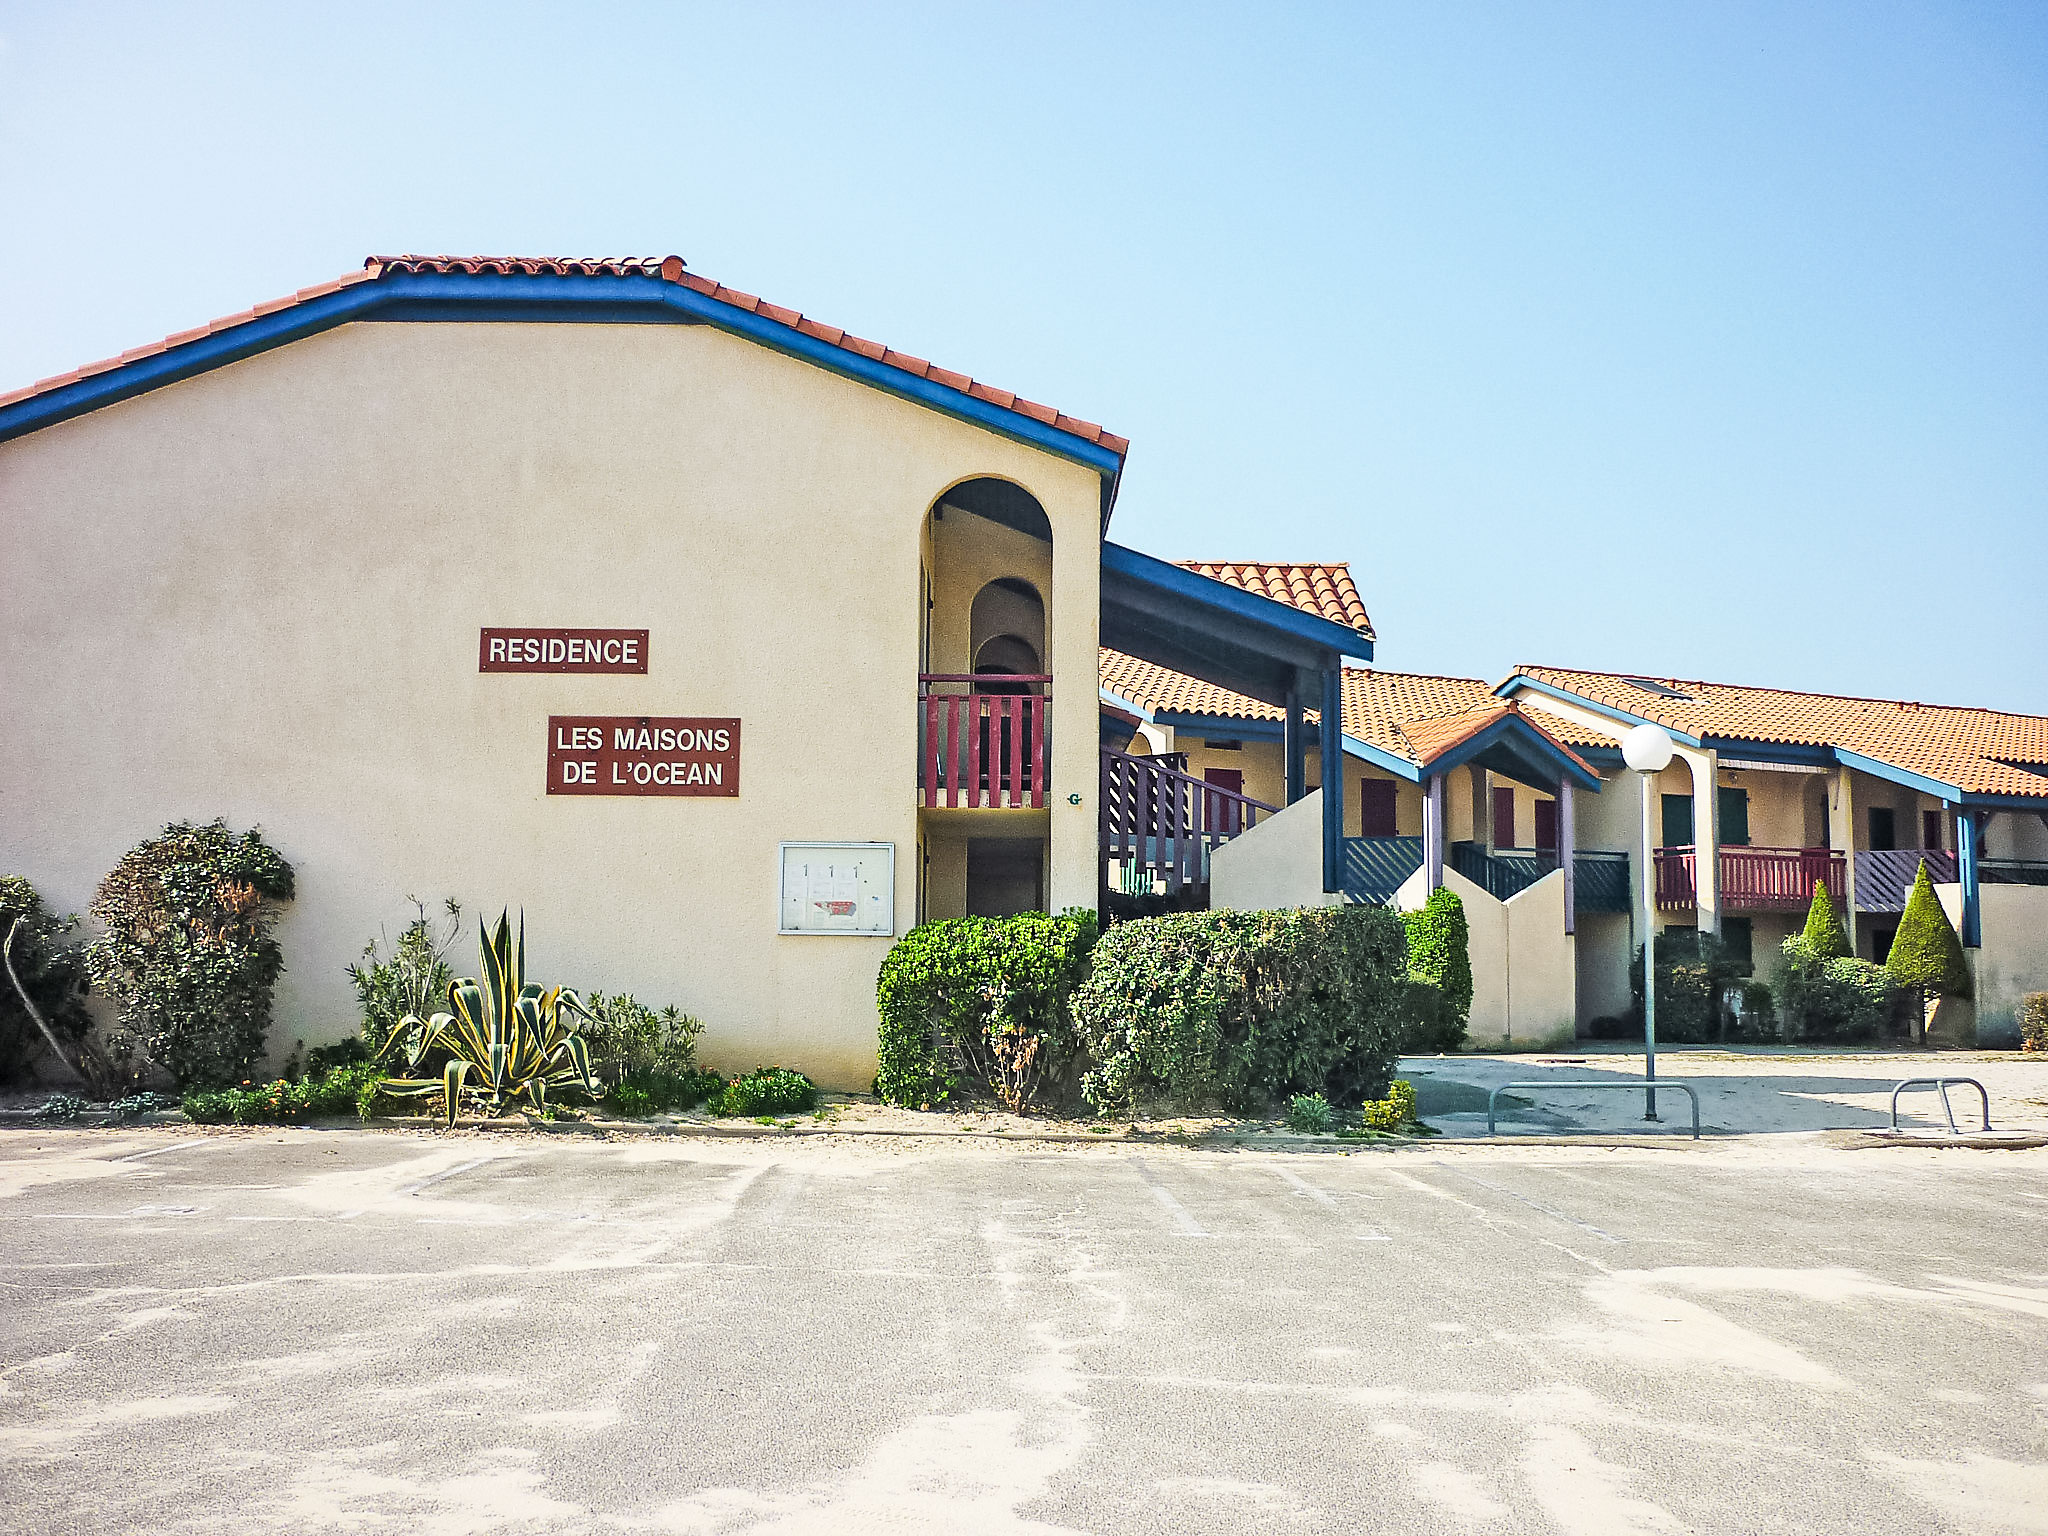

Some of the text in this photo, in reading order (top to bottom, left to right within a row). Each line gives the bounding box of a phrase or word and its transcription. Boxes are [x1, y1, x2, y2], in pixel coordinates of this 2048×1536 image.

[489, 637, 639, 664] RESIDENCE
[556, 726, 730, 752] LES MAISONS
[563, 761, 723, 785] DE L'OCEAN
[1068, 793, 1080, 805] G
